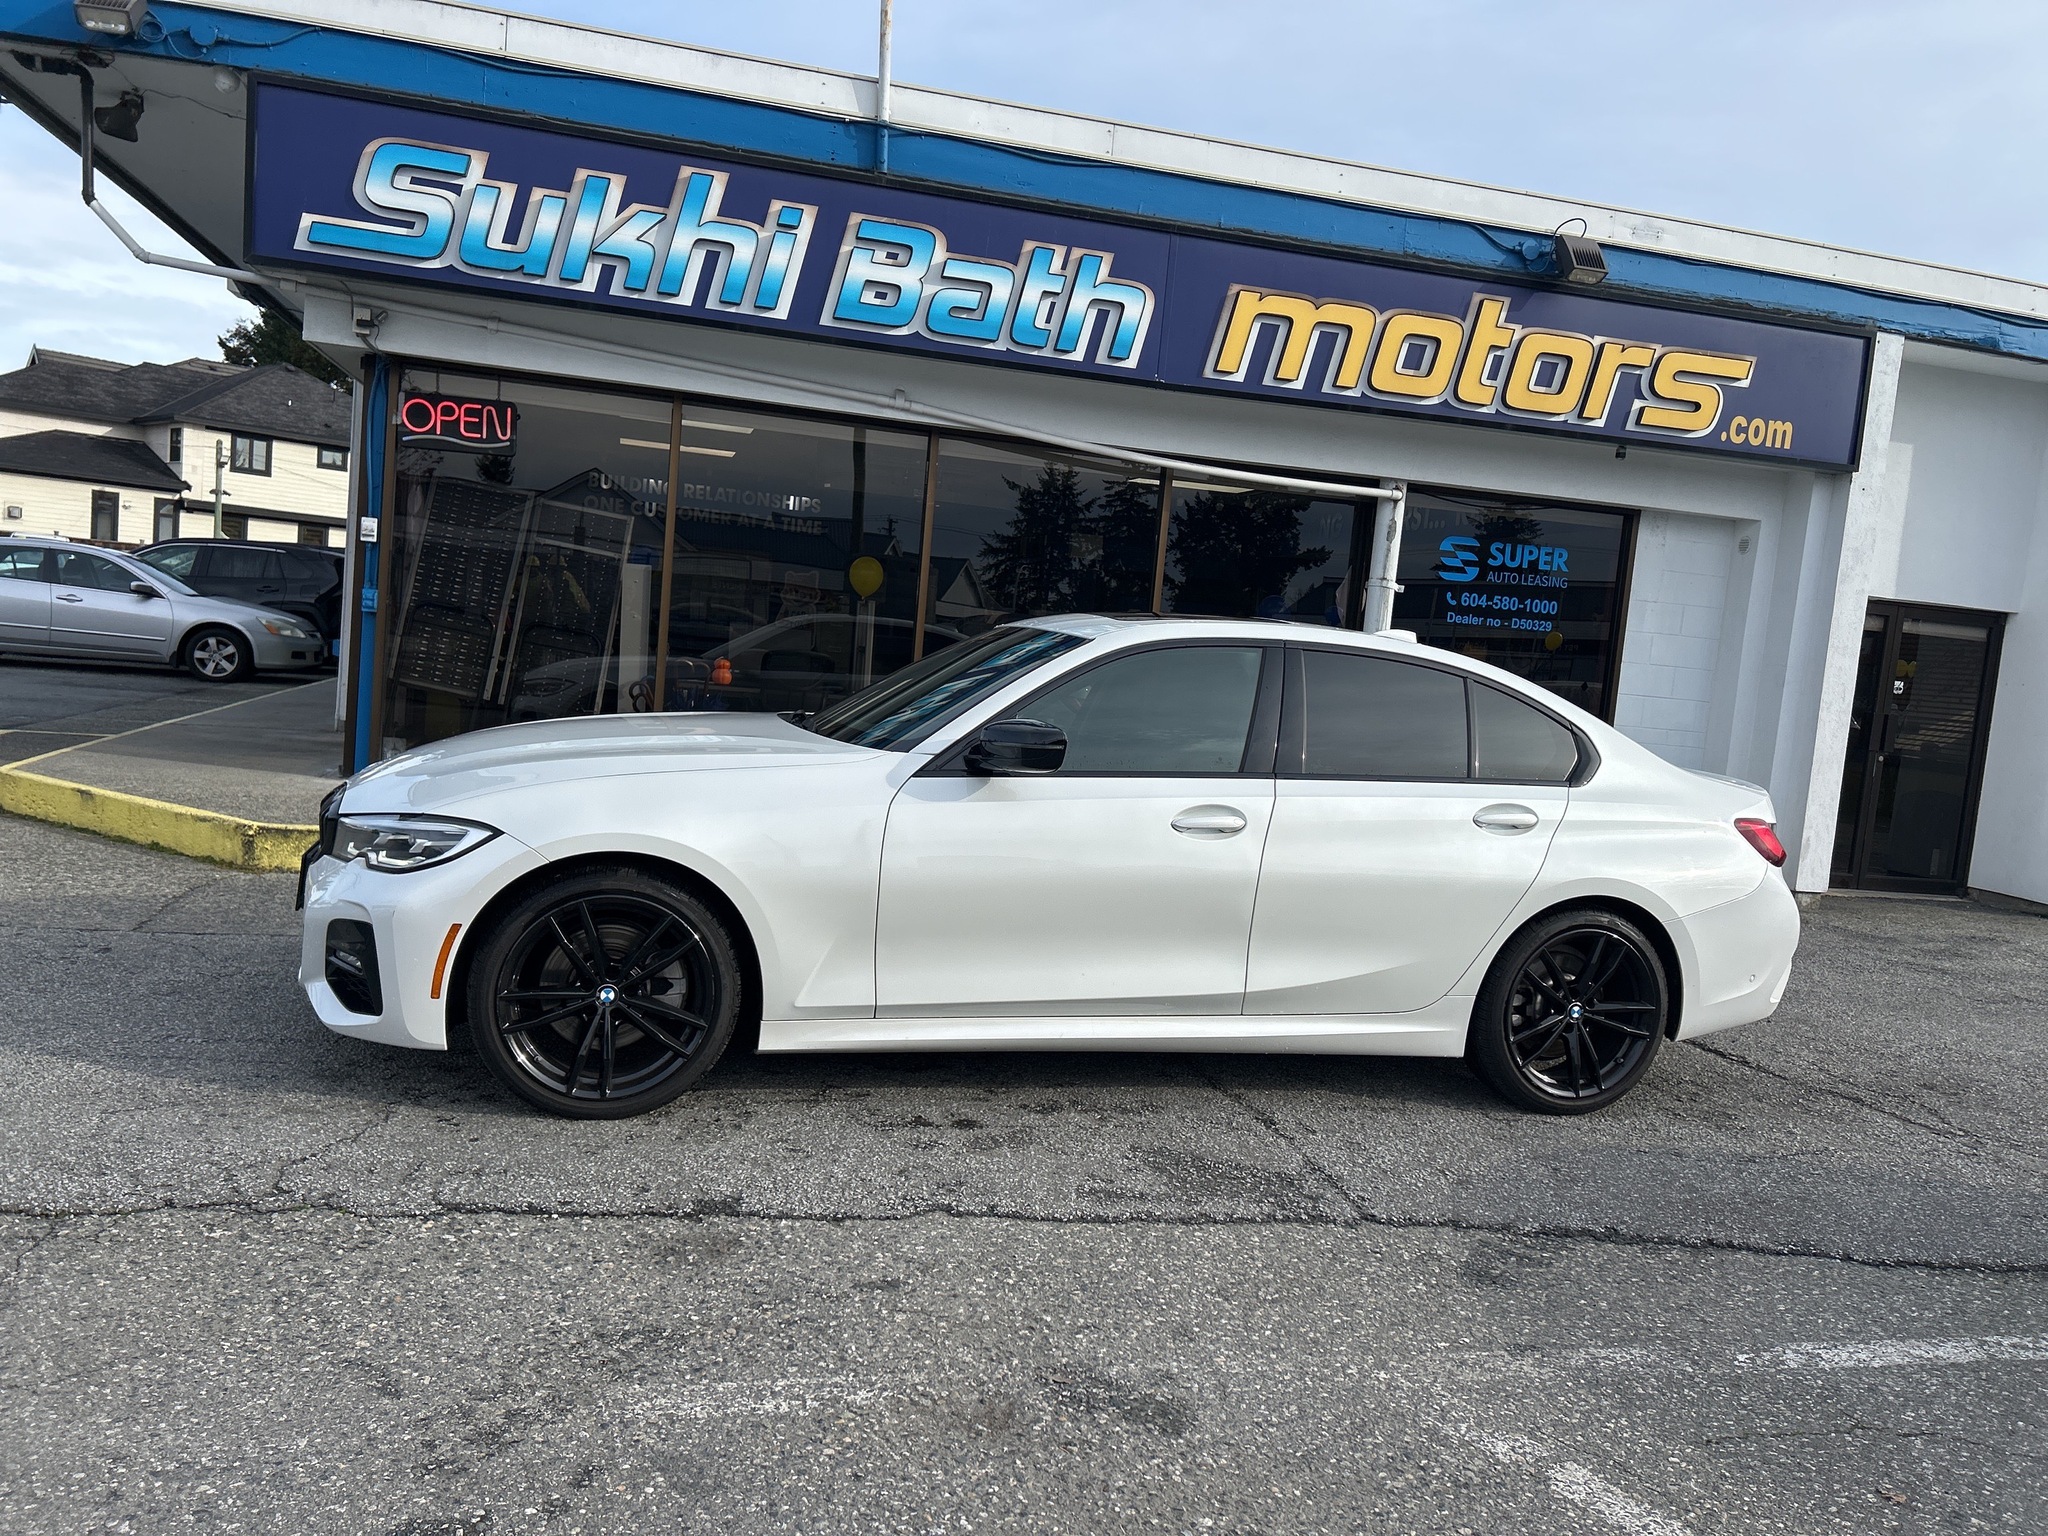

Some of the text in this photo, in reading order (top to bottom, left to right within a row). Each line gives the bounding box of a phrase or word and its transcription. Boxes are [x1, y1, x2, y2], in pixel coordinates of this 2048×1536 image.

[293, 137, 818, 320] Sukhi
[819, 212, 1156, 369] Bath
[402, 398, 512, 441] OPEN
[683, 483, 822, 513] RELATIONSHIPS
[583, 495, 625, 514] ONE
[630, 500, 732, 525] CUSOMER
[781, 516, 823, 536] TIME
[1487, 541, 1569, 573] SUPER
[1486, 571, 1568, 589] AUTO LEASING
[1461, 592, 1558, 615] 604-580-1000
[1447, 612, 1484, 627] Dealer
[1486, 617, 1501, 628] no
[1511, 618, 1553, 632] D50329
